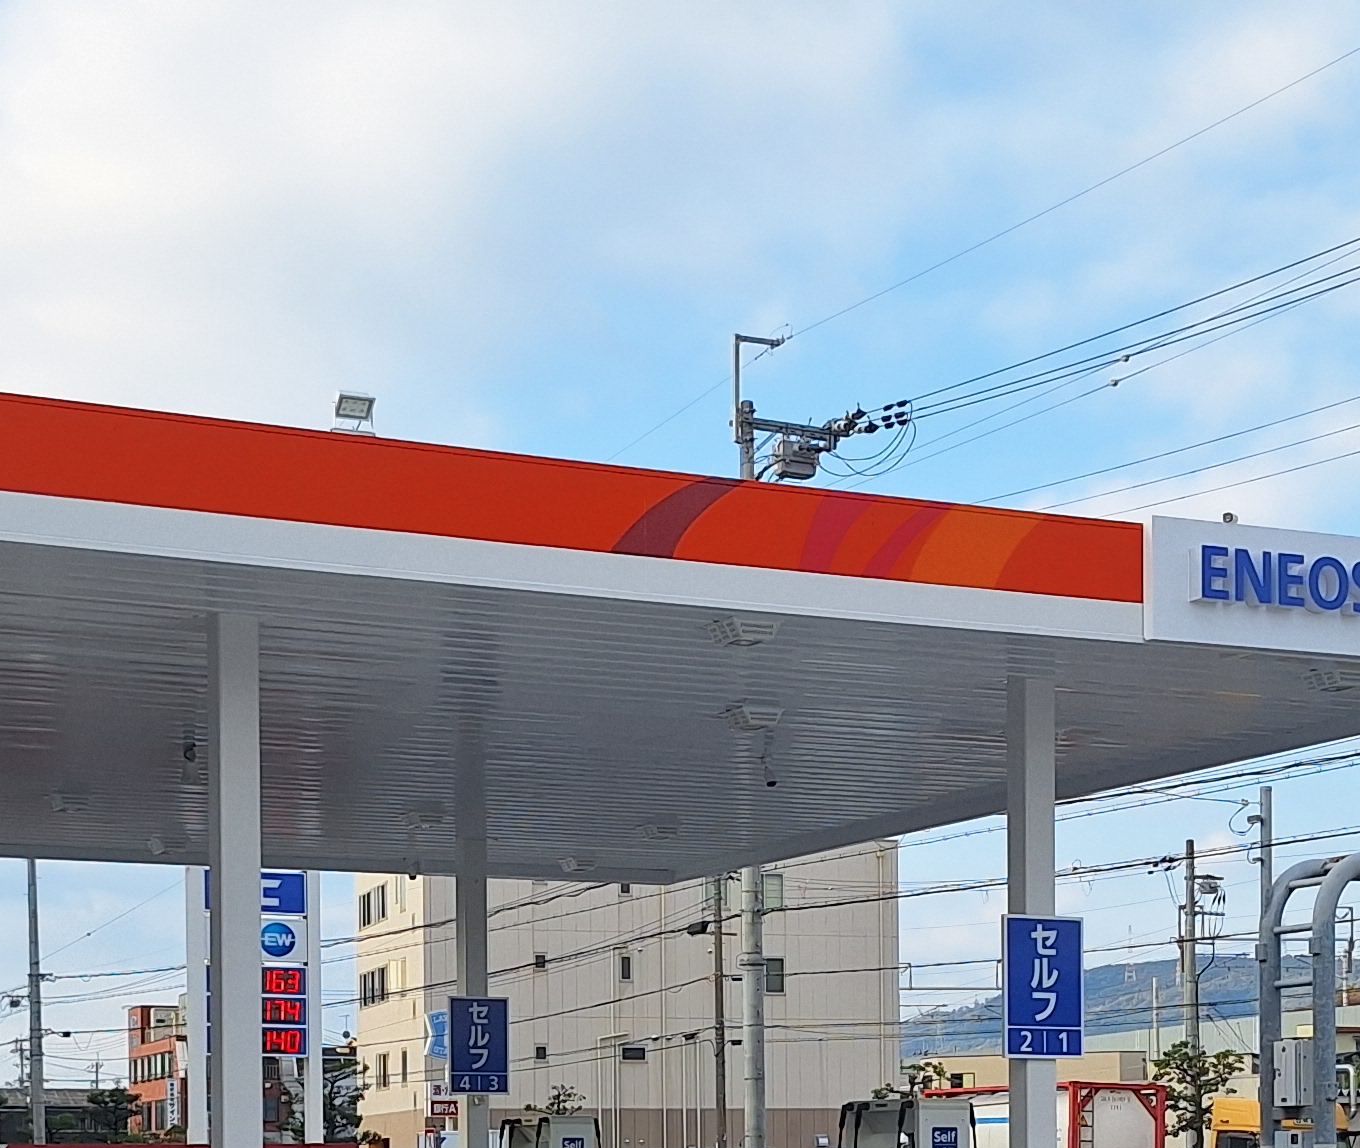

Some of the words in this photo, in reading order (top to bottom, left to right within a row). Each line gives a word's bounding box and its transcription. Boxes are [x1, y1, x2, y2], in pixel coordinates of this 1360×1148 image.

[265, 969, 300, 994] 163
[1030, 923, 1059, 1022] セルフ
[265, 1000, 300, 1021] 174
[265, 1030, 300, 1053] 140
[468, 1002, 490, 1070] セルフ
[1020, 1031, 1033, 1052] 2
[1058, 1031, 1068, 1052] 1
[459, 1075, 471, 1091] 4
[488, 1075, 499, 1091] 3
[433, 1103, 458, 1114] 銀行A
[933, 1130, 956, 1143] Self
